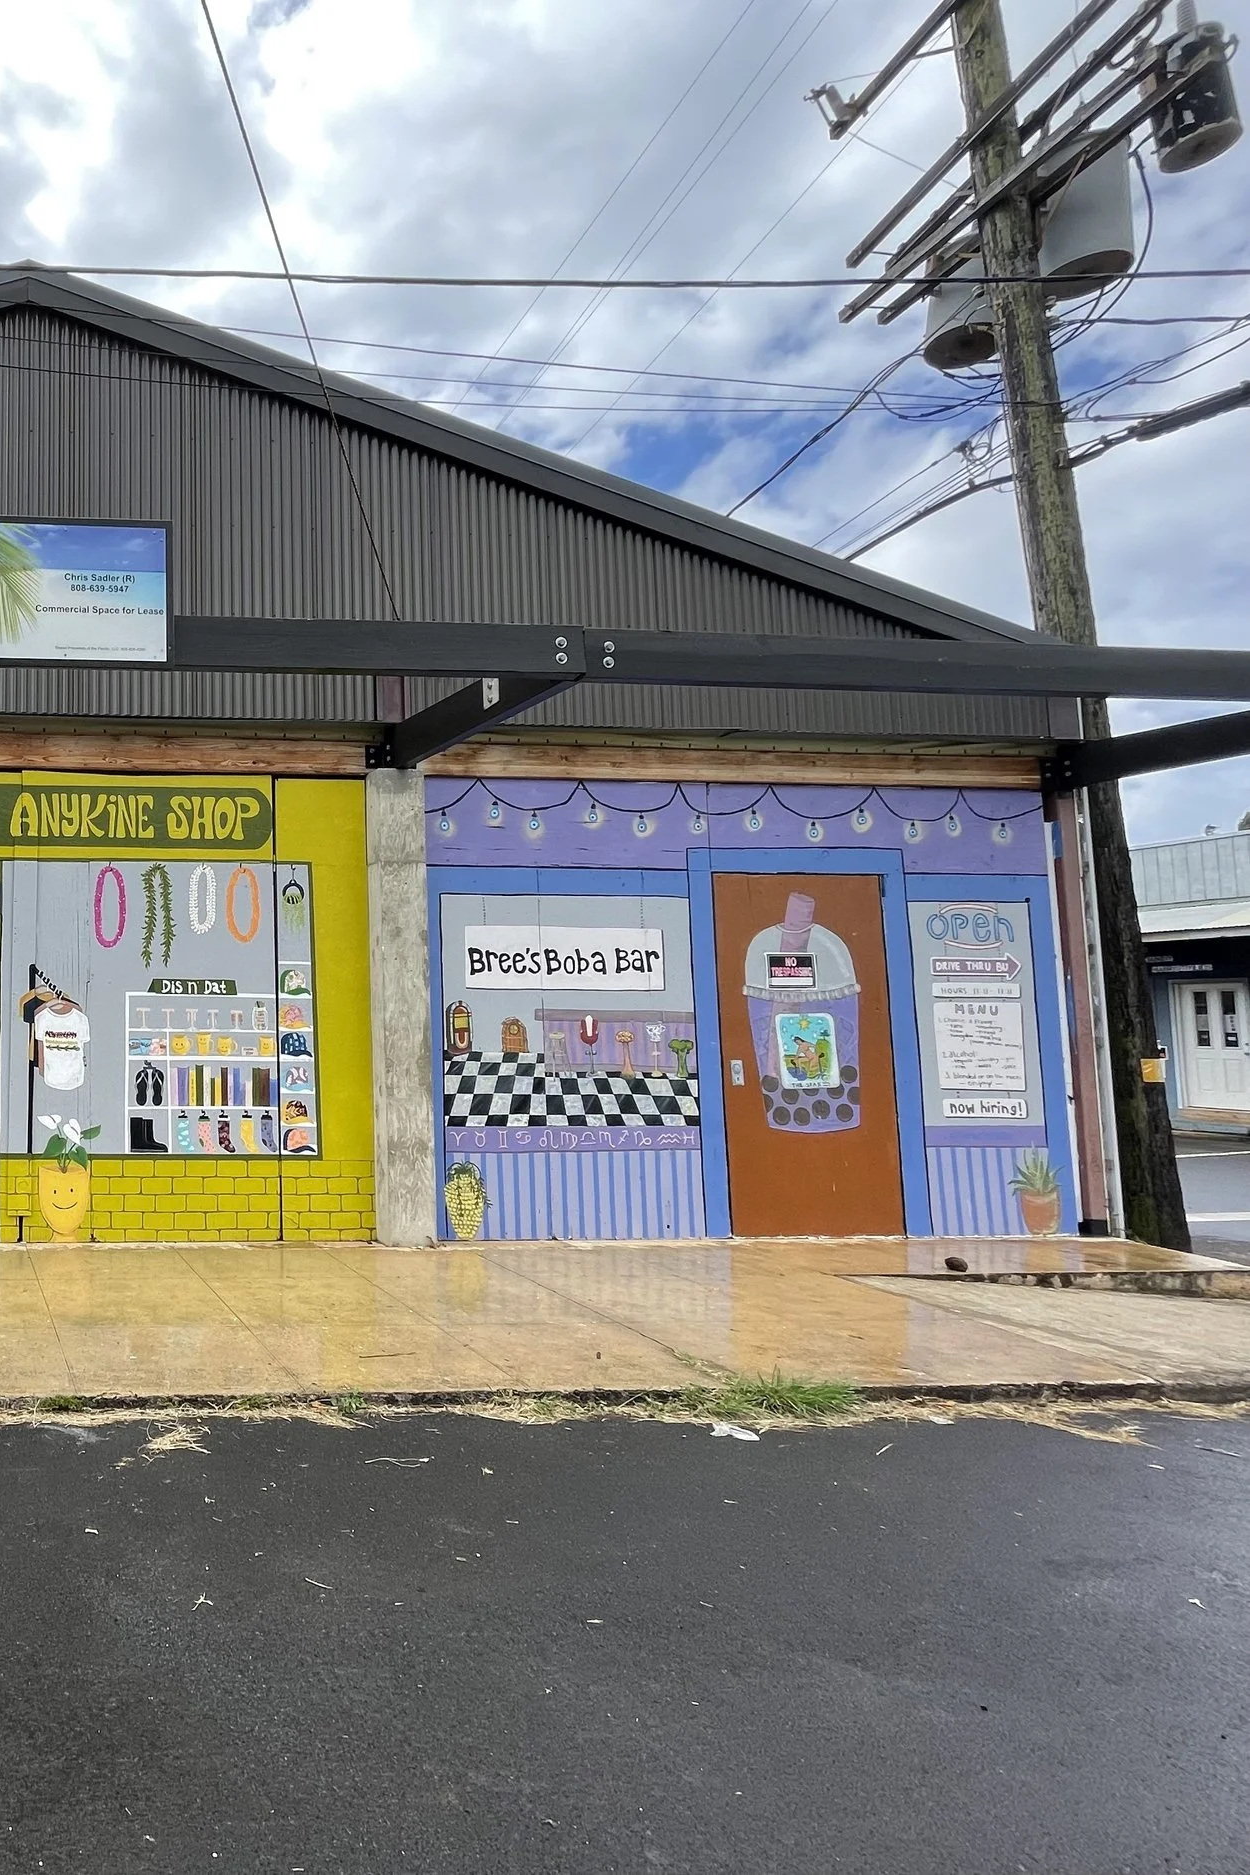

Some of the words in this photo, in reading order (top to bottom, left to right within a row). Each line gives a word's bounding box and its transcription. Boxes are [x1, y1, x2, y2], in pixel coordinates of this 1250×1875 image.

[64, 573, 88, 582] Chris
[91, 573, 120, 583] Sadler
[122, 575, 136, 584] (R)
[70, 584, 129, 593] 808-639-5947
[35, 604, 90, 614] Commercial
[92, 606, 120, 616] Space
[122, 606, 136, 615] for
[137, 607, 164, 616] Lease
[166, 795, 261, 841] SHOP
[467, 947, 541, 976] Bree's
[543, 947, 607, 976] Boba
[615, 947, 660, 974] Bar
[784, 957, 798, 967] NO
[935, 961, 961, 971] DRIVE
[965, 961, 991, 971] THRU
[770, 966, 813, 977] TRESPASSING
[161, 980, 183, 993] Dis
[203, 980, 227, 994] Dat
[954, 1003, 999, 1016] MENU
[949, 1102, 975, 1114] now
[980, 1100, 1023, 1117] hiring!
